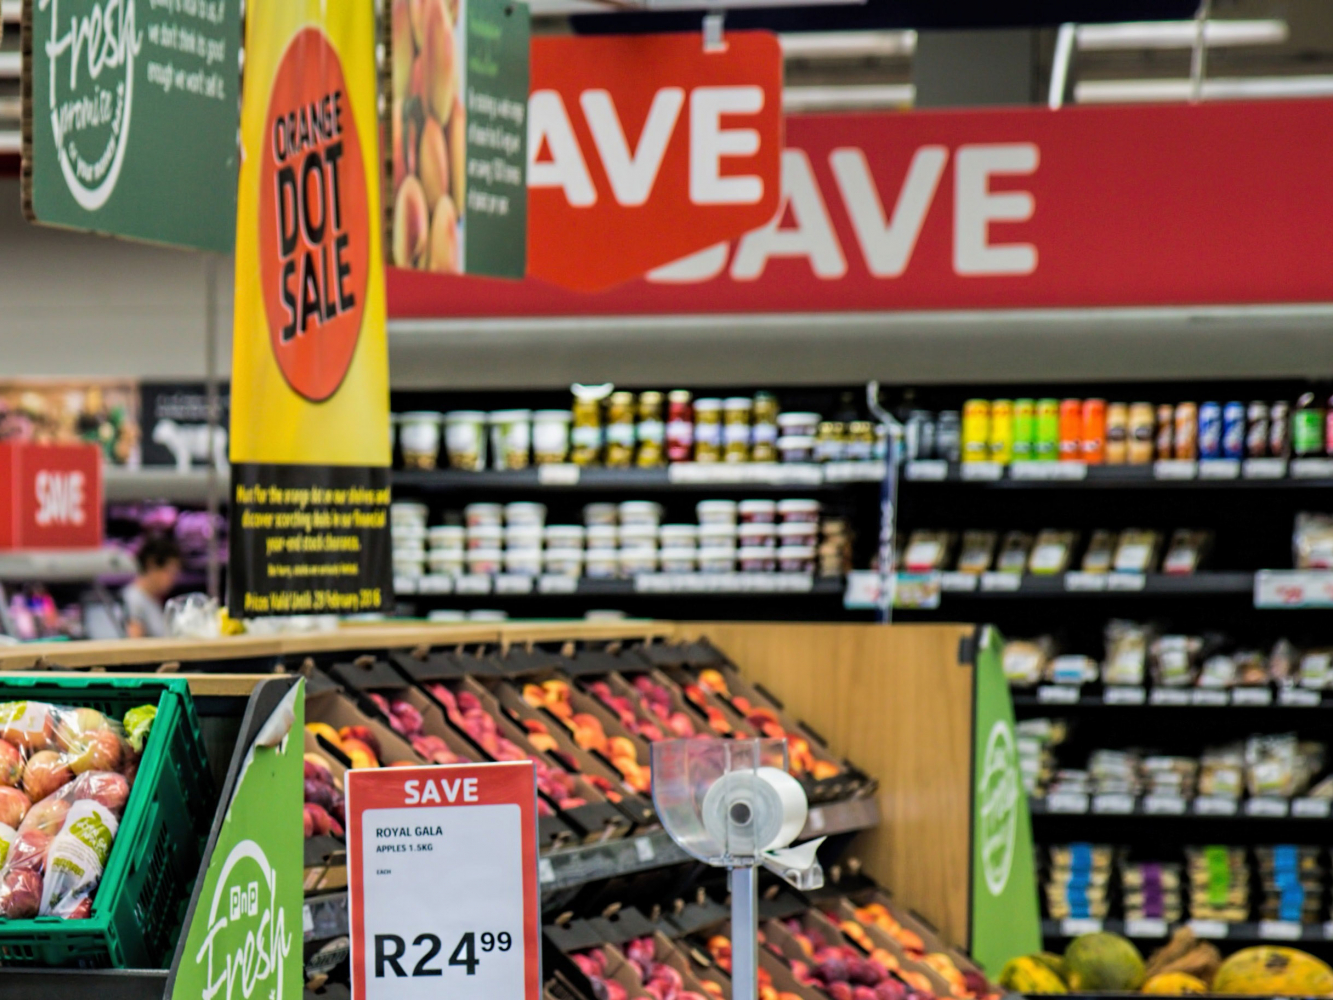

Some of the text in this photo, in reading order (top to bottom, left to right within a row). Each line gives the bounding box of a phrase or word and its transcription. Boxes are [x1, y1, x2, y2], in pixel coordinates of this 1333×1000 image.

[273, 91, 343, 165] ORANGE
[527, 86, 765, 207] AVE
[275, 141, 343, 261] DOT
[645, 142, 1041, 284] AVE
[280, 233, 355, 345] SALE
[35, 470, 85, 526] SAVE
[404, 777, 479, 804] SAVE
[376, 826, 443, 838] ROYAL GALA
[376, 843, 433, 853] APPLES 1.5KG
[230, 881, 259, 921] PnP
